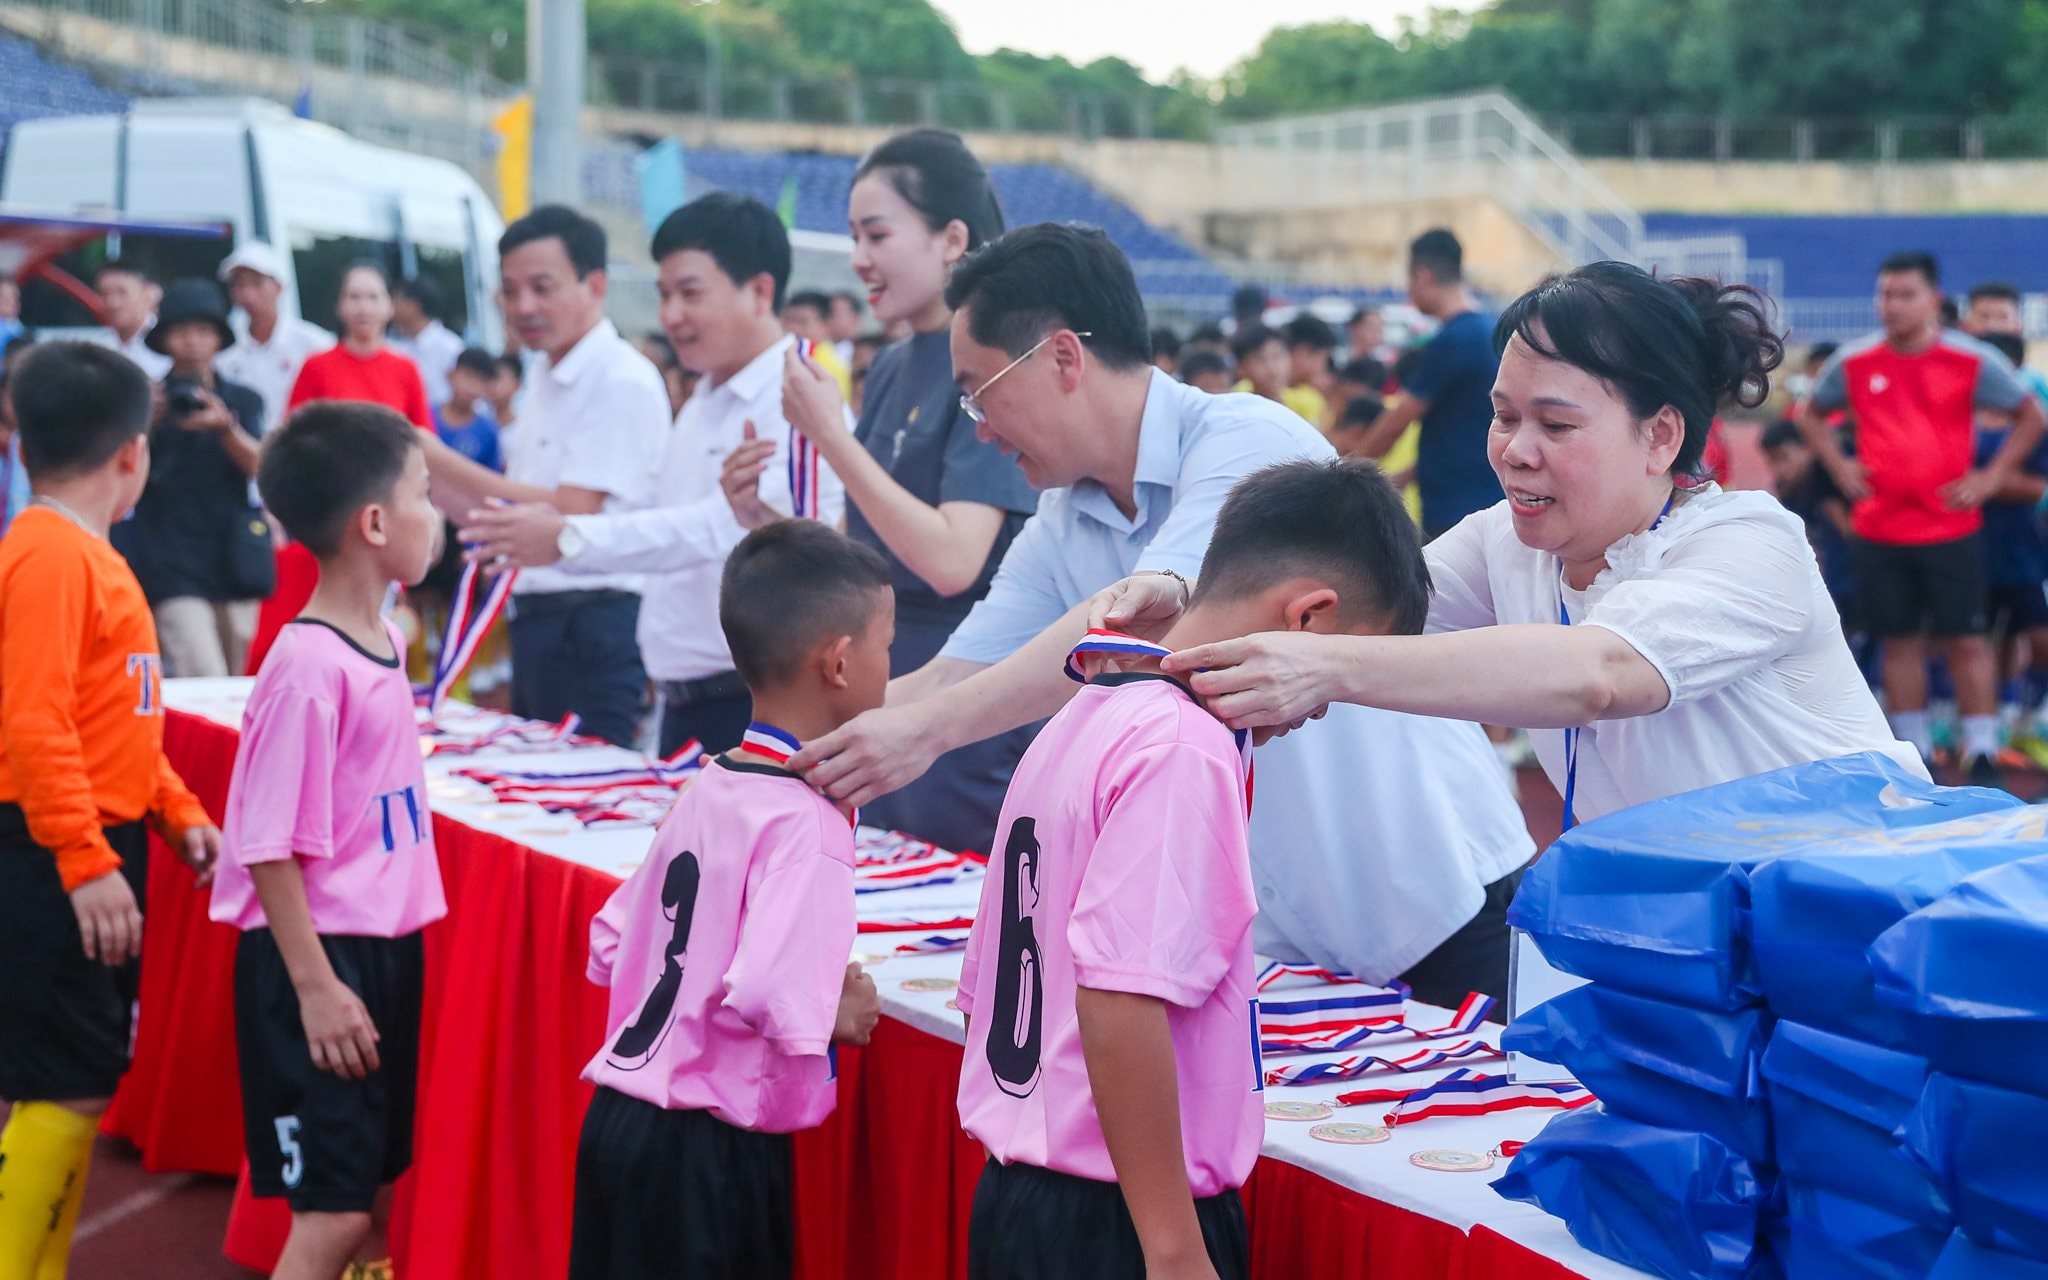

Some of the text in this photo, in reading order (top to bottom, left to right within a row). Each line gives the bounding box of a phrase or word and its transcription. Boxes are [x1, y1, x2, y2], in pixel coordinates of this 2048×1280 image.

[606, 850, 700, 1071] 3
[986, 816, 1045, 1099] 6
[273, 1114, 304, 1189] 5
